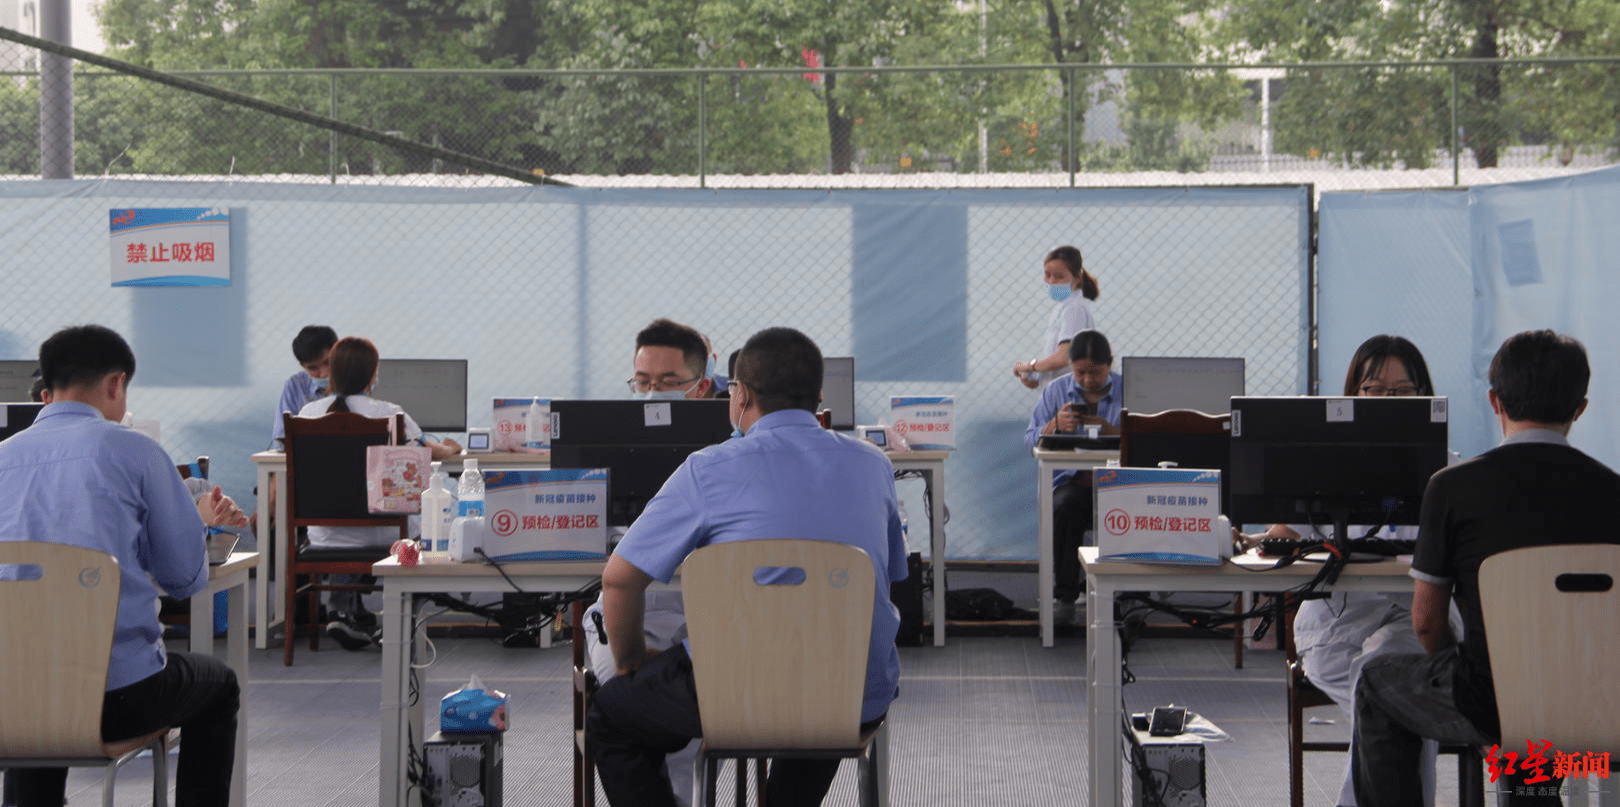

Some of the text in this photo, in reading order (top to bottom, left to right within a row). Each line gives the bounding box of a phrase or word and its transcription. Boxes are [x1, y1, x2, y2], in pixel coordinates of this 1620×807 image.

[127, 242, 215, 263] 禁止吸烟
[521, 514, 600, 530] 预检/登记区
[1134, 516, 1212, 533] 预检/登记区
